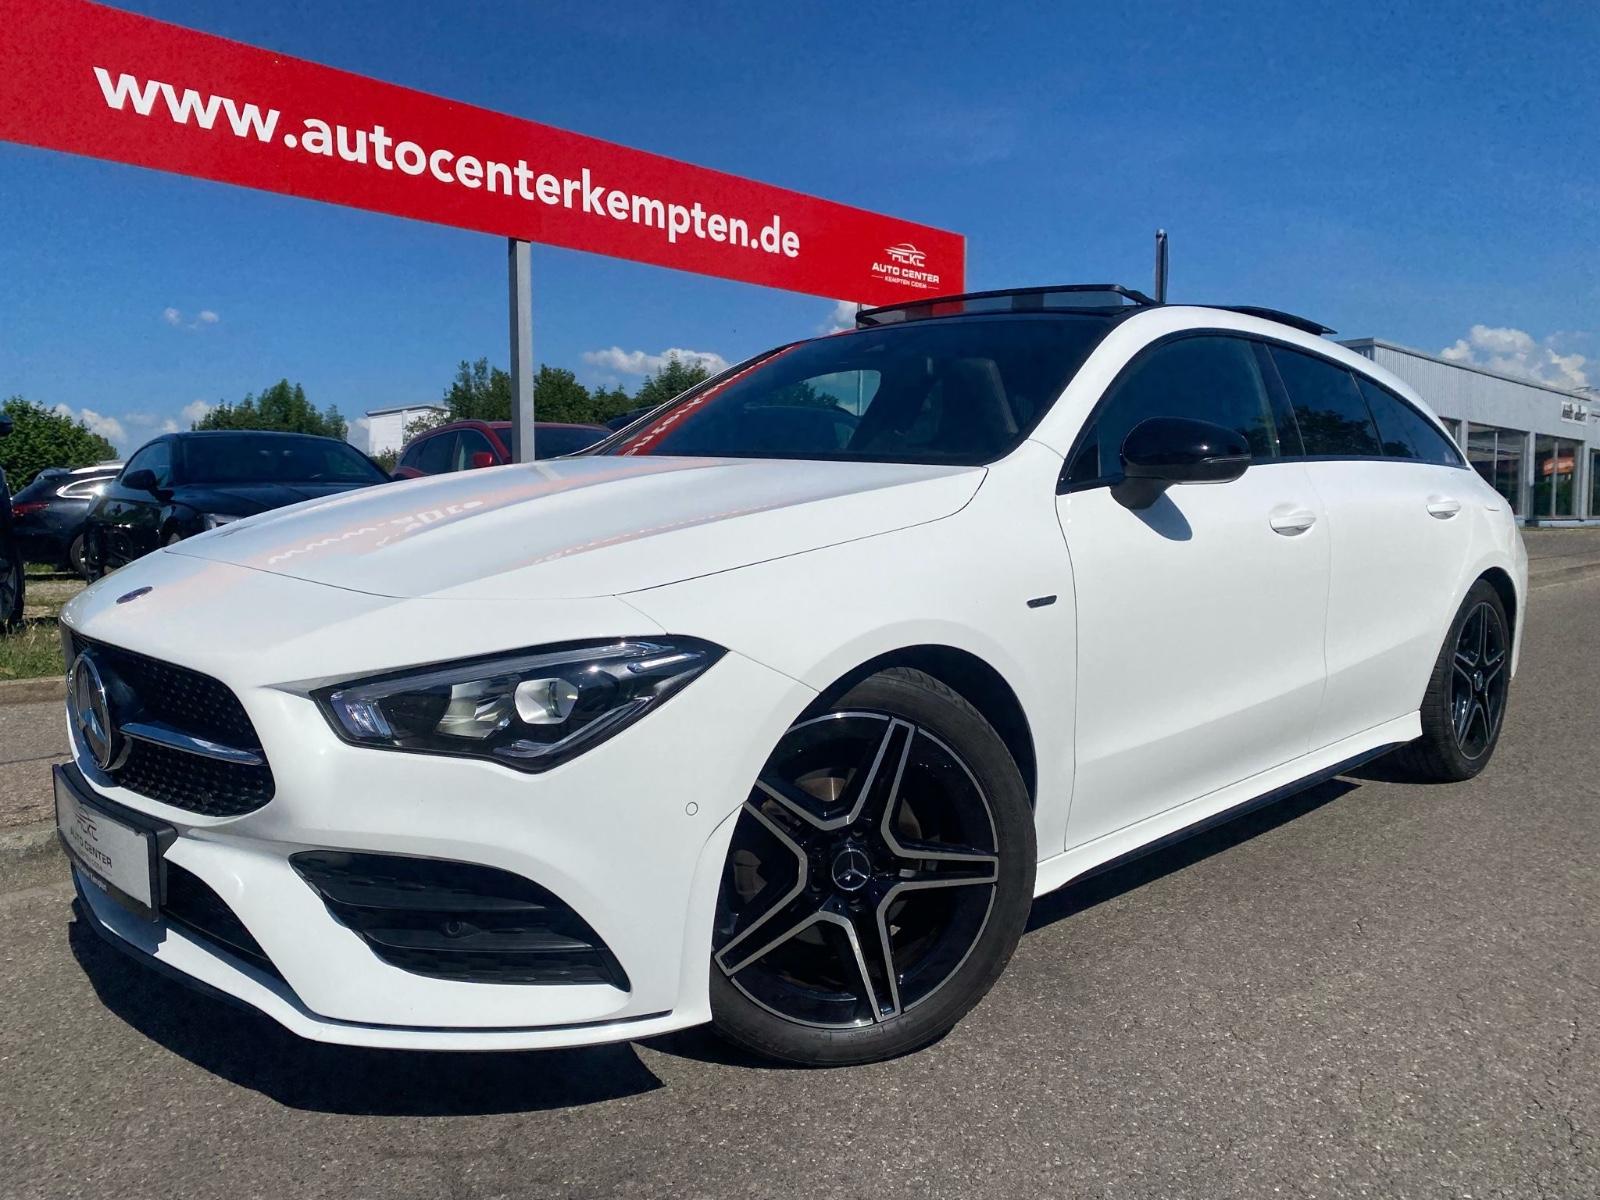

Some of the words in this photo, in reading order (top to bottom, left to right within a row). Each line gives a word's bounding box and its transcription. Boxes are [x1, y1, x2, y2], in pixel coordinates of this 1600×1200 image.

[93, 67, 800, 258] www.autocenterkempten.de
[872, 262, 900, 275] AUTO
[902, 268, 940, 283] CENTER
[885, 276, 910, 286] KEMPTEN
[84, 841, 112, 868] CENTER
